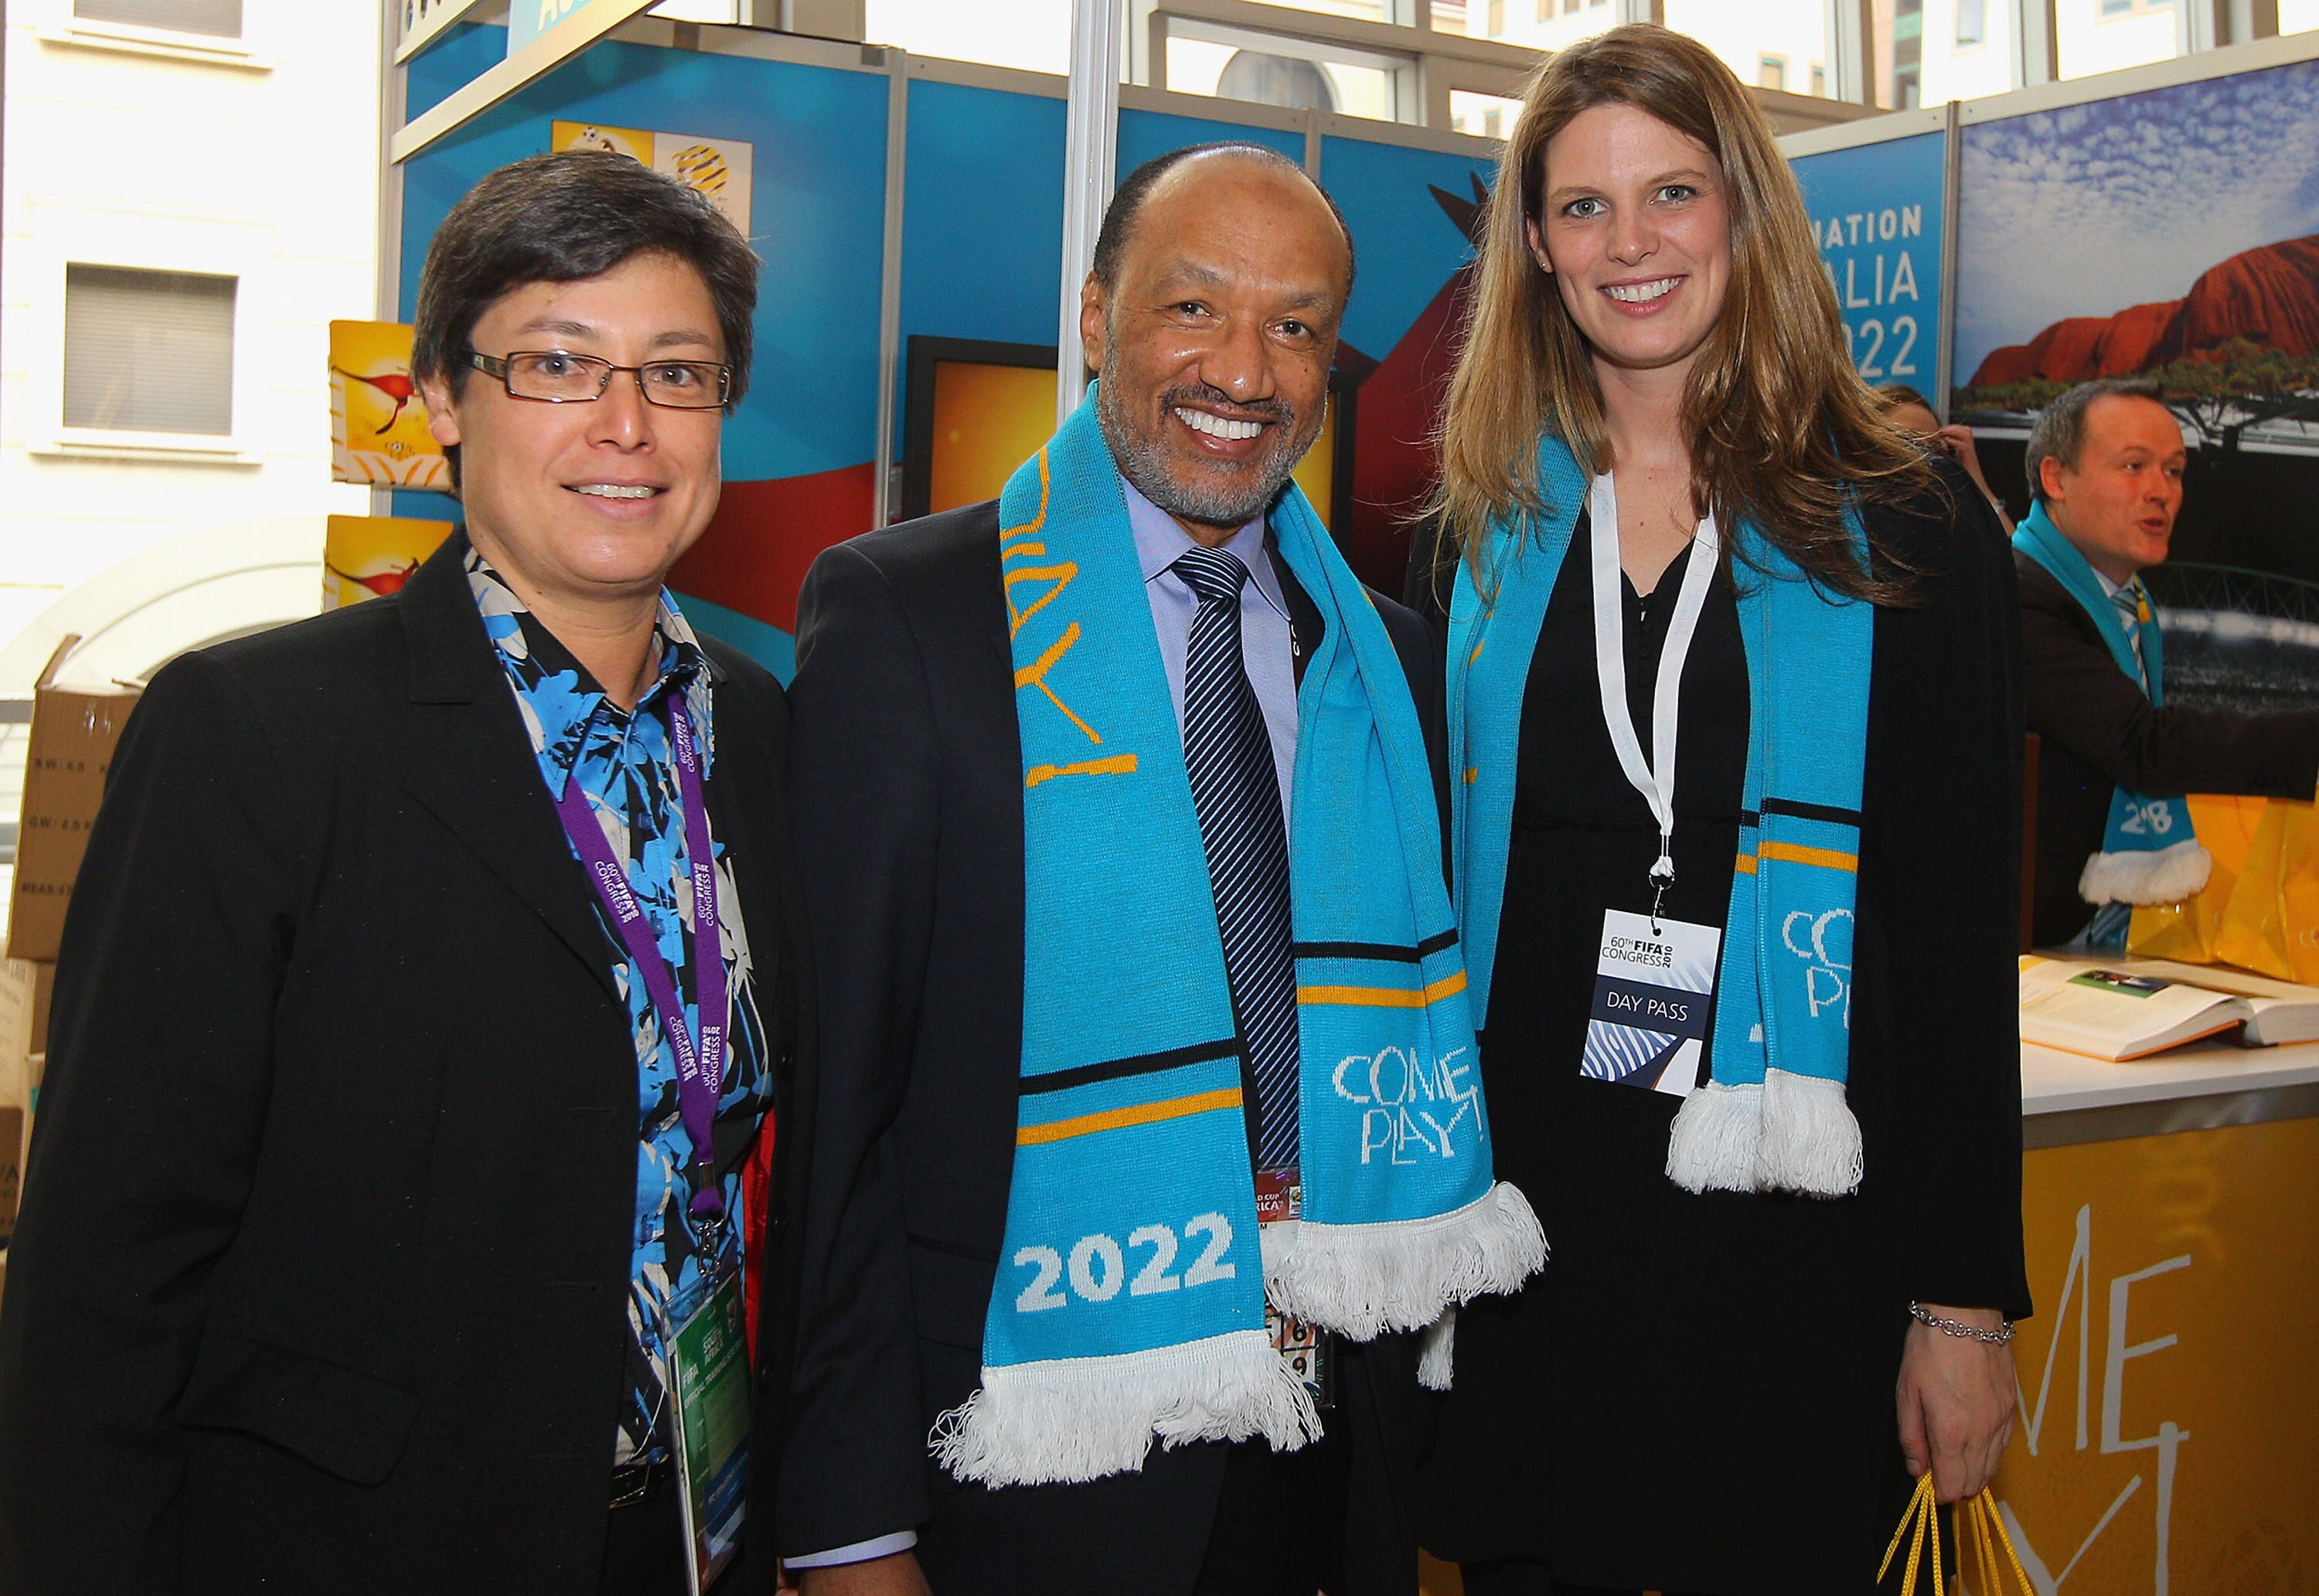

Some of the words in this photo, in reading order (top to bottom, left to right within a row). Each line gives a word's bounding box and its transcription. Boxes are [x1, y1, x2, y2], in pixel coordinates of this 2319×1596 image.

[681, 724, 695, 773] CONGRESS
[595, 861, 628, 915] CONGRESS
[606, 863, 623, 883] 60TH
[616, 881, 635, 910] FIFA
[695, 873, 704, 898] FIFA
[697, 898, 707, 919] 60TH
[702, 873, 714, 927] CONGRESS
[1602, 947, 1662, 967] CONGRESS
[1610, 936, 1633, 948] 60TH
[1634, 940, 1663, 955] FIFA
[1661, 945, 1674, 968] 2010
[1606, 991, 1643, 1012] DAY
[1646, 999, 1689, 1022] PASS
[669, 1016, 690, 1073] CONGRESS
[683, 1038, 696, 1067] FIFA
[700, 1036, 711, 1064] FIFA
[710, 1036, 721, 1094] CONGRESS
[1332, 1045, 1475, 1106] COME
[1360, 1084, 1485, 1166] PLAY!
[1013, 1210, 1236, 1313] 2022
